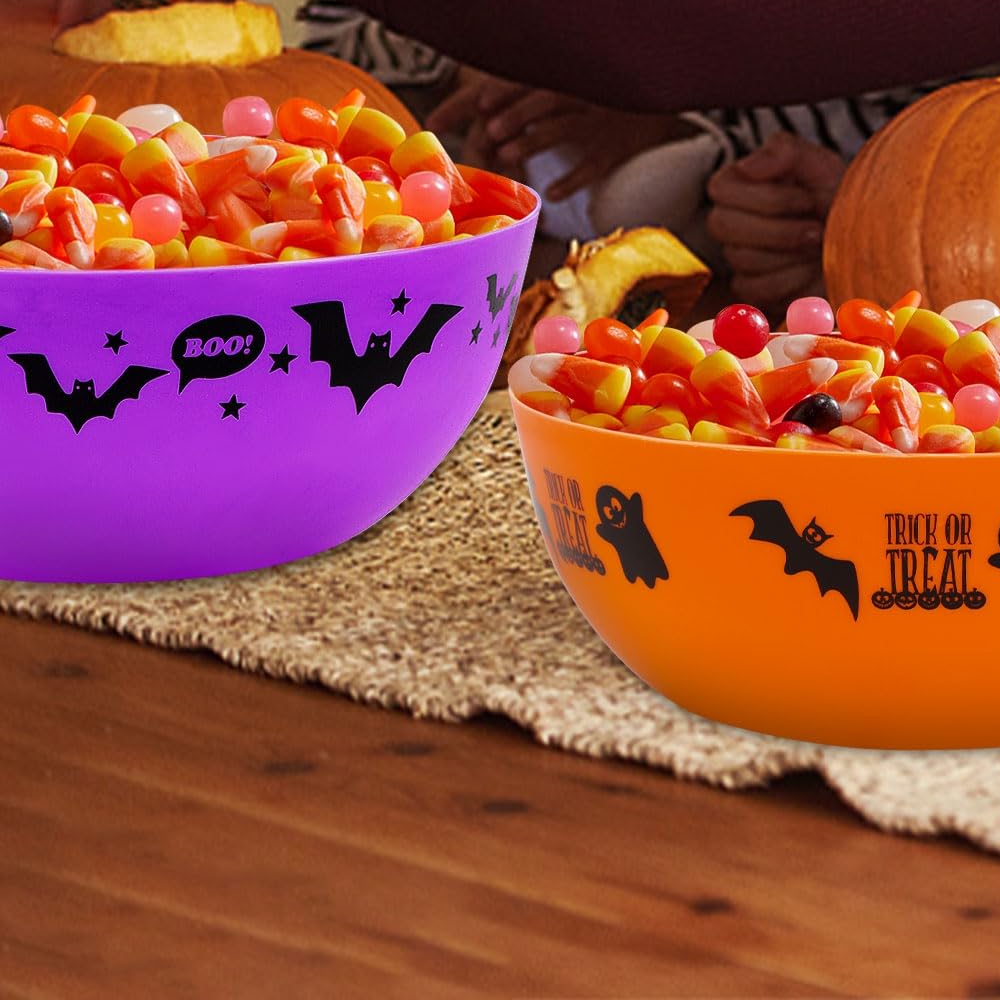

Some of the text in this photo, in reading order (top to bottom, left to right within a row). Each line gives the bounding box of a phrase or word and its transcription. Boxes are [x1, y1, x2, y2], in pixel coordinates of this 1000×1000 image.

[183, 335, 254, 358] BOO!
[945, 513, 972, 545] OR
[886, 546, 972, 596] TREAT
